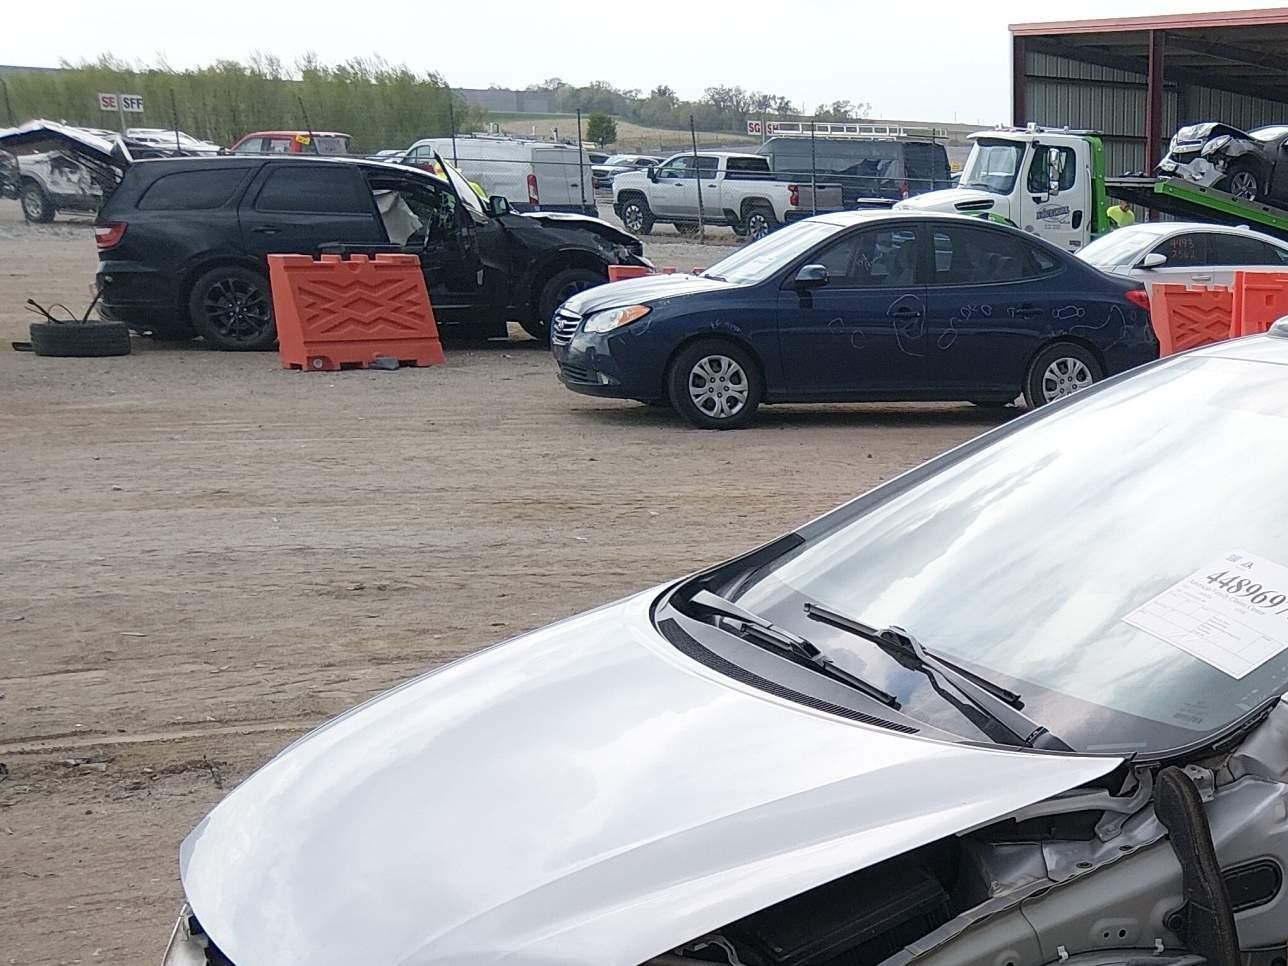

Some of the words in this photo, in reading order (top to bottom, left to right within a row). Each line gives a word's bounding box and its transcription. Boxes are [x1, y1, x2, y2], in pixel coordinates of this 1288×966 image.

[101, 96, 117, 108] SE
[123, 97, 144, 109] SFF
[748, 122, 761, 133] SG
